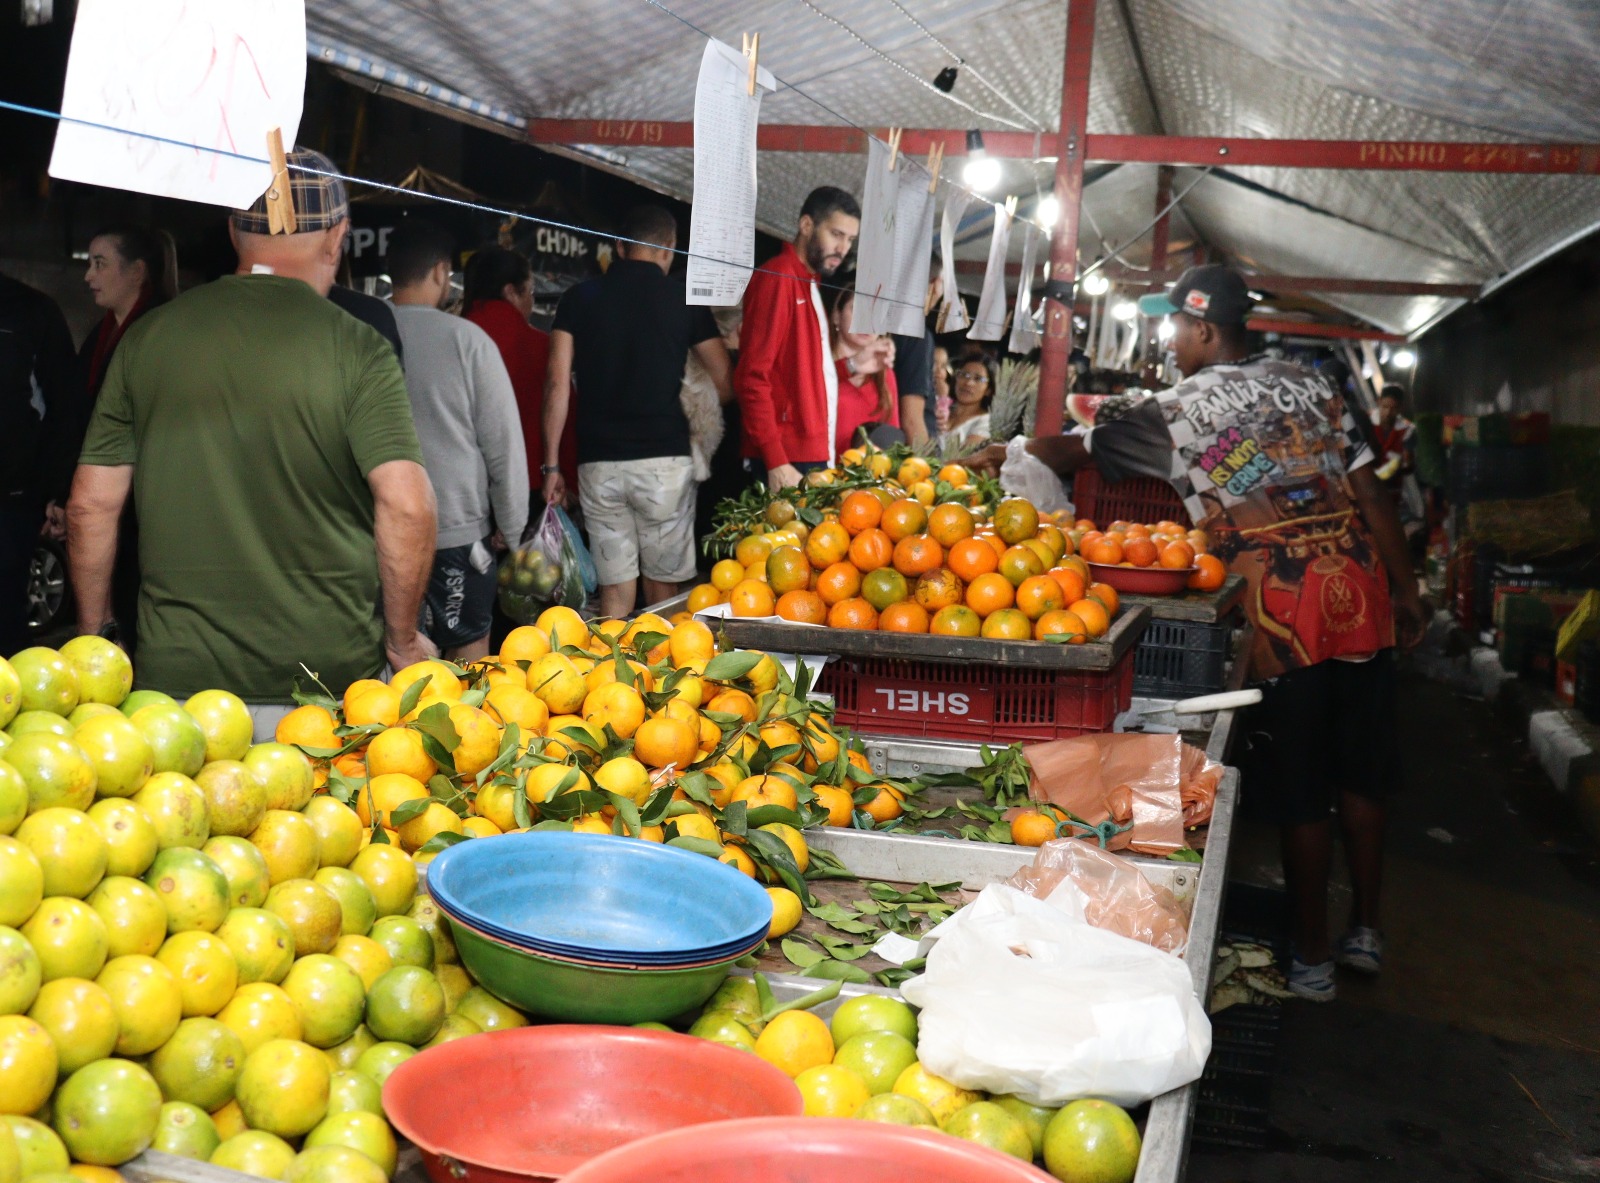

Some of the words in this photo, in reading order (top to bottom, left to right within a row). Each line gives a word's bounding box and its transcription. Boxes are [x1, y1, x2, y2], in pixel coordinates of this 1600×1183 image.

[1360, 144, 1446, 163] PINHO
[1200, 426, 1243, 471] #244
[1224, 438, 1258, 471] NOT
[1226, 451, 1275, 496] CRIME
[446, 577, 465, 629] SPORTS
[875, 688, 970, 715] SHEL
